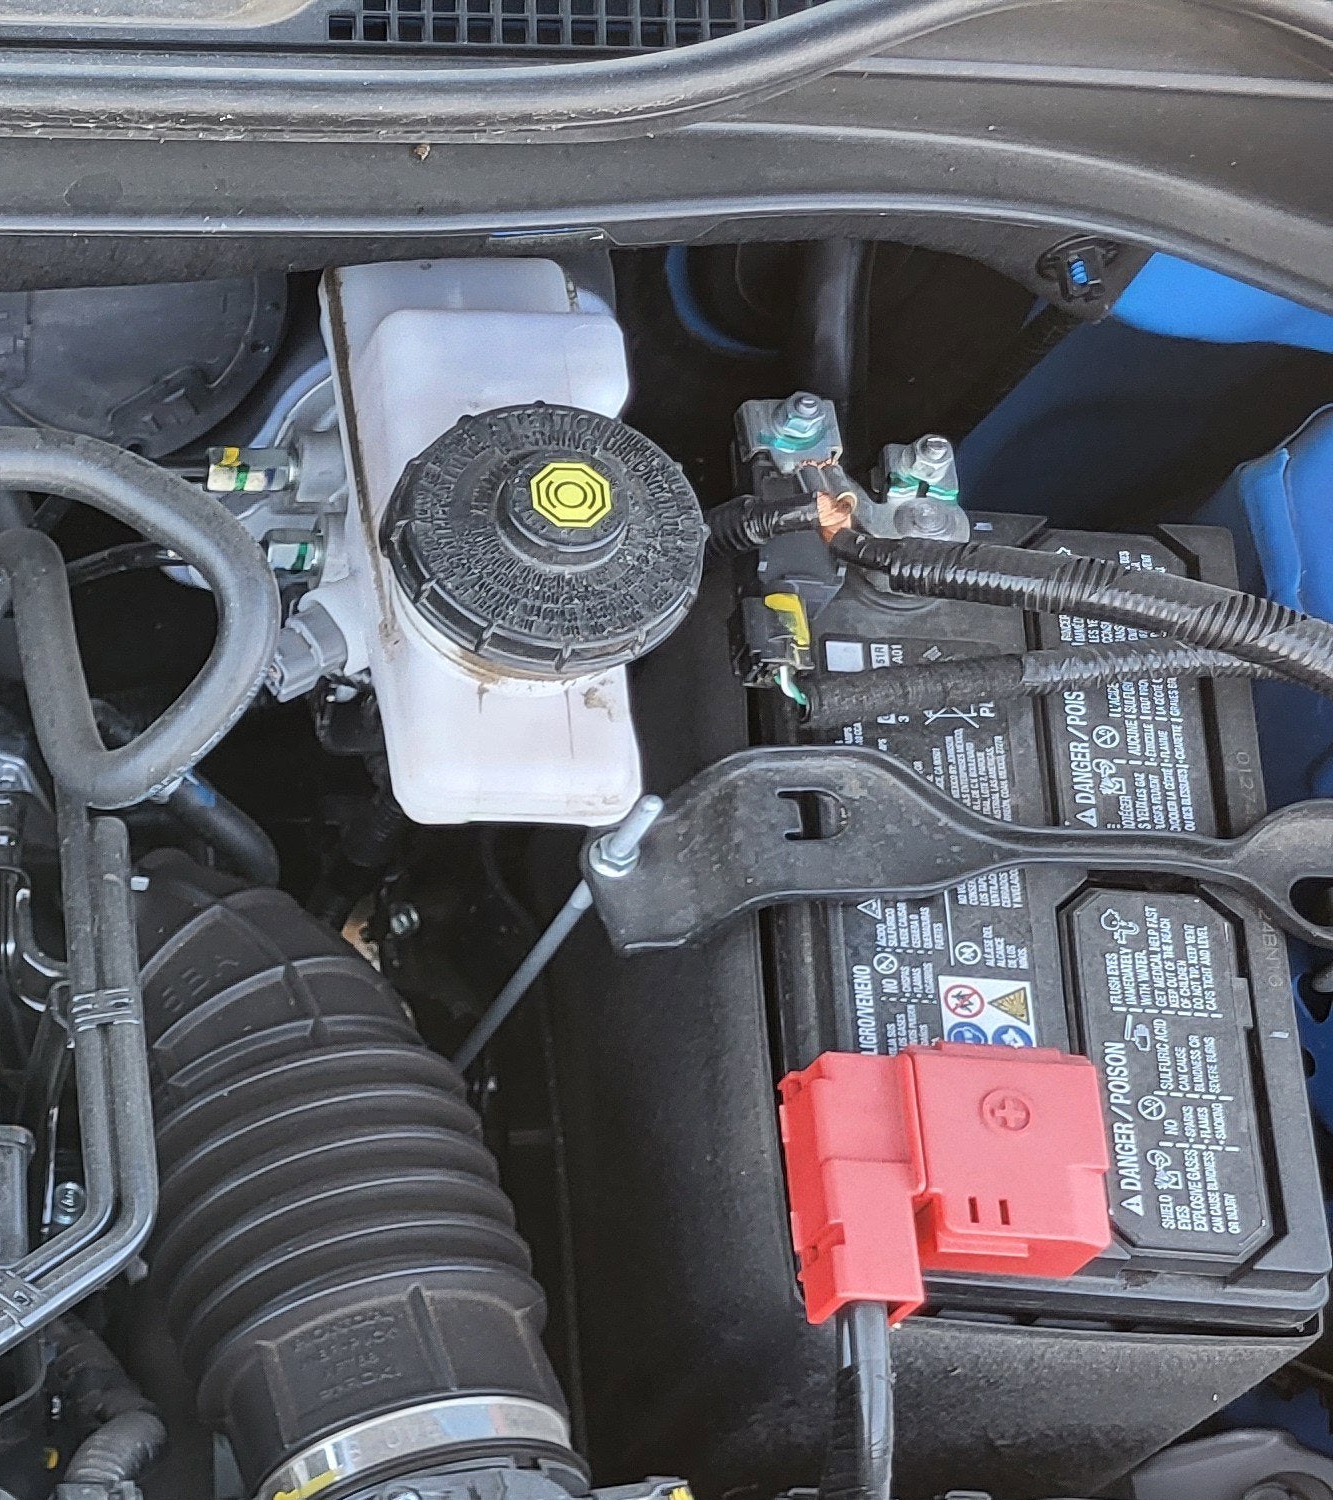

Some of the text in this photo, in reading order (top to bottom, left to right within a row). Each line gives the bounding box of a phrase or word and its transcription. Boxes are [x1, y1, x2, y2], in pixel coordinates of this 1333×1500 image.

[1087, 619, 1098, 628] YE
[874, 646, 886, 664] 51R
[892, 644, 904, 664] A01
[1119, 796, 1135, 829] OTÉGER
[1160, 917, 1173, 943] REACH
[1183, 923, 1196, 944] VENT
[1194, 925, 1209, 948] LEVEL
[1144, 905, 1168, 1007] GET MEDICAL HELP FAST
[1163, 959, 1175, 970] OF
[1186, 944, 1199, 964] KEEP
[882, 979, 898, 993] NO
[1104, 952, 1123, 1004] FLUSH EYES
[1119, 947, 1137, 1005] IMMEDIATELY
[1163, 971, 1177, 988] OUT
[1176, 959, 1193, 1009] OF CHILDREN
[1199, 967, 1214, 988] TIGHT
[1139, 983, 1152, 1006] WITH
[1166, 989, 1180, 1009] KEEP
[1190, 980, 1203, 997] NOT
[852, 965, 877, 1055] LIGRO/VENENO
[1191, 997, 1205, 1010] DO
[1153, 1018, 1175, 1090] SULFURIC ACID
[1174, 1046, 1191, 1091] CAN CAUSE
[1163, 1119, 1179, 1135] NO
[1197, 1106, 1211, 1139] FLAMES
[1212, 1103, 1227, 1140] SMOKING
[1183, 1149, 1209, 1231] EXPLOSIVE GASES
[1158, 1194, 1177, 1229] SHIELD
[1208, 1192, 1222, 1216] CAUSE
[1175, 1205, 1192, 1230] EYES
[1212, 1216, 1225, 1234] CAN
